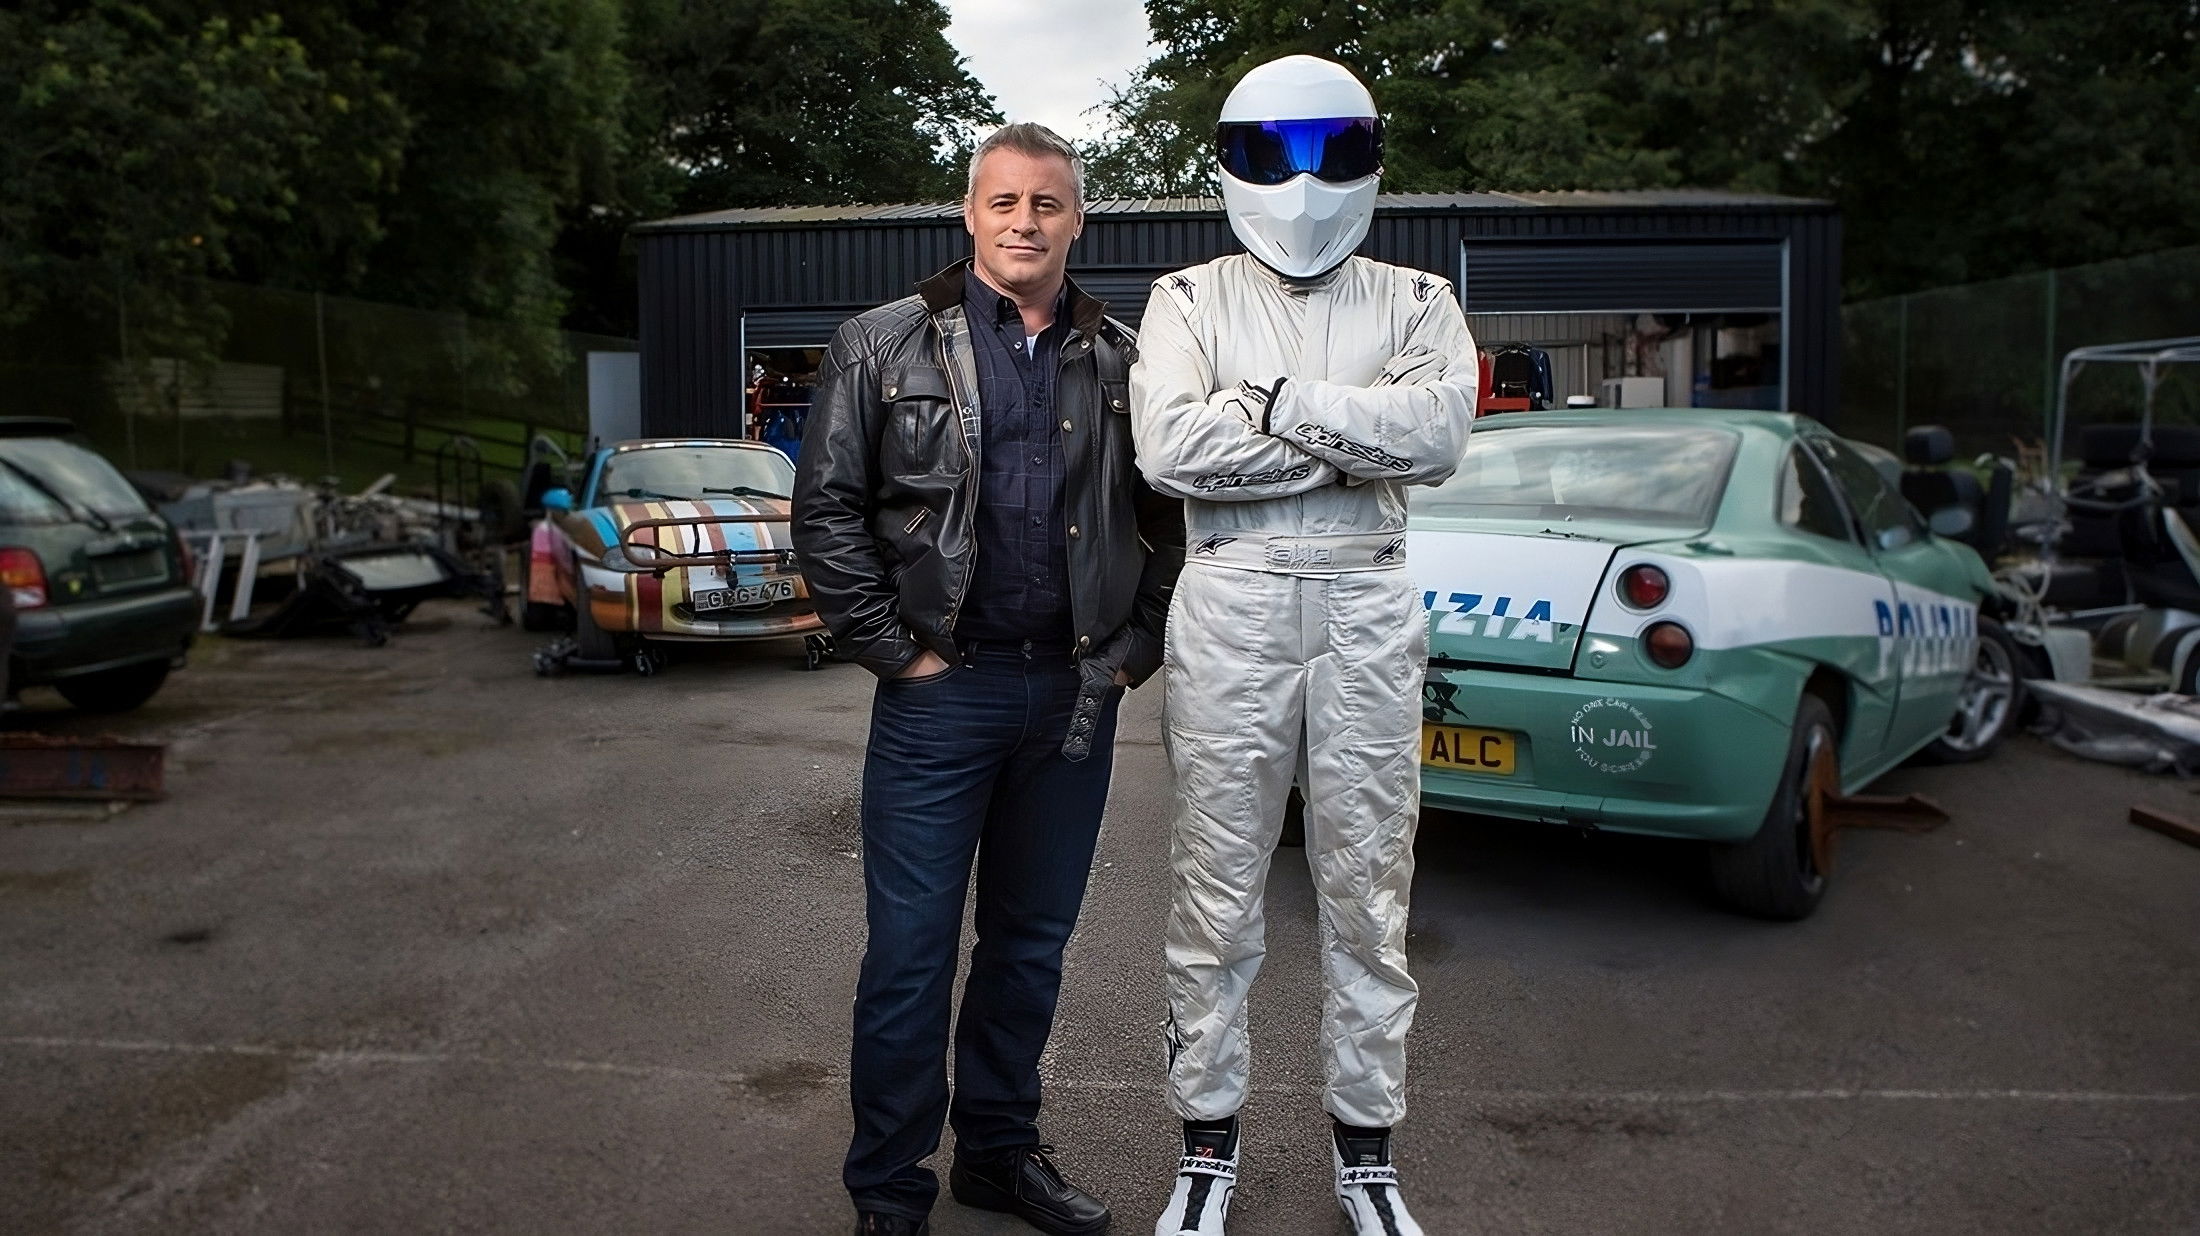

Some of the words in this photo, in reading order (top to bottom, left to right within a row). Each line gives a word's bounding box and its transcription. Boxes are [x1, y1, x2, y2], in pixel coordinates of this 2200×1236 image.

[1430, 731, 1501, 768] ALC
[1571, 725, 1594, 744] IN
[1602, 728, 1657, 750] JAIL
